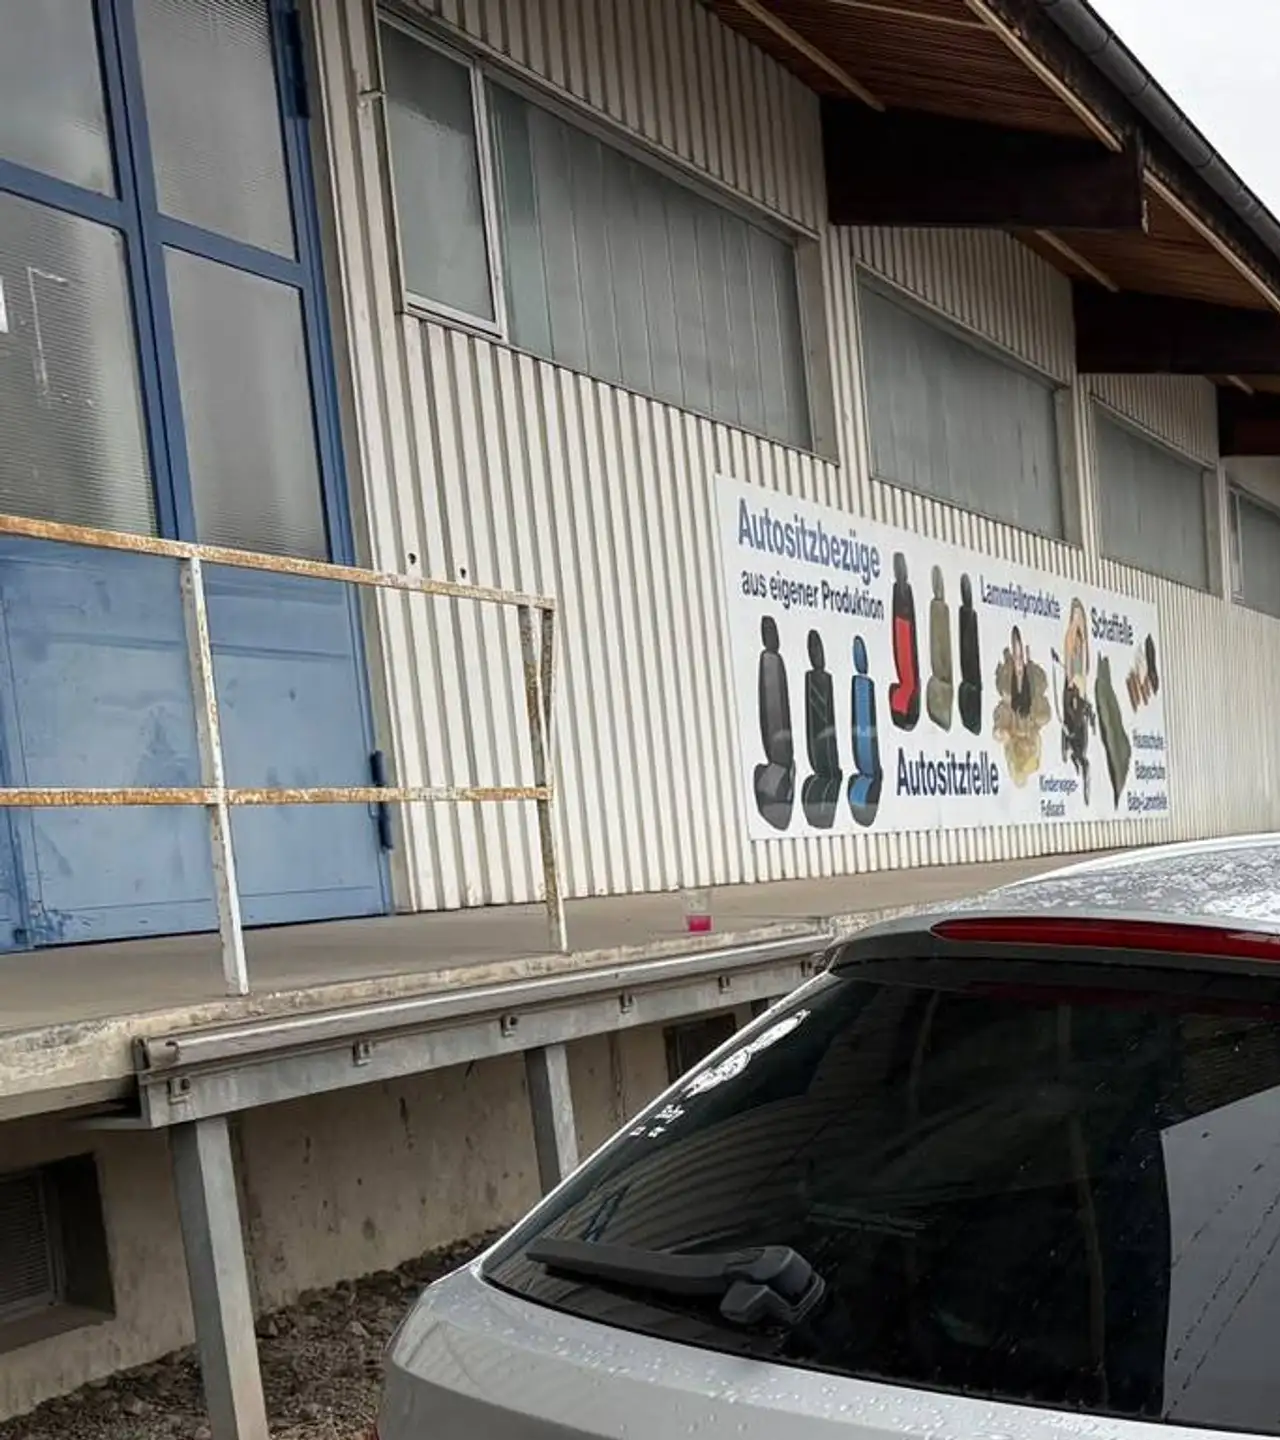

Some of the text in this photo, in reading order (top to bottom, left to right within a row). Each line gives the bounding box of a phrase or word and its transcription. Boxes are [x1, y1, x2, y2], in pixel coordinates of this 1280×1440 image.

[738, 497, 881, 586] Autositzbezüge
[741, 570, 885, 621] aus eigener Produktion
[980, 574, 1061, 619] Lammfellprodukte
[896, 747, 999, 797] Autositzfelle
